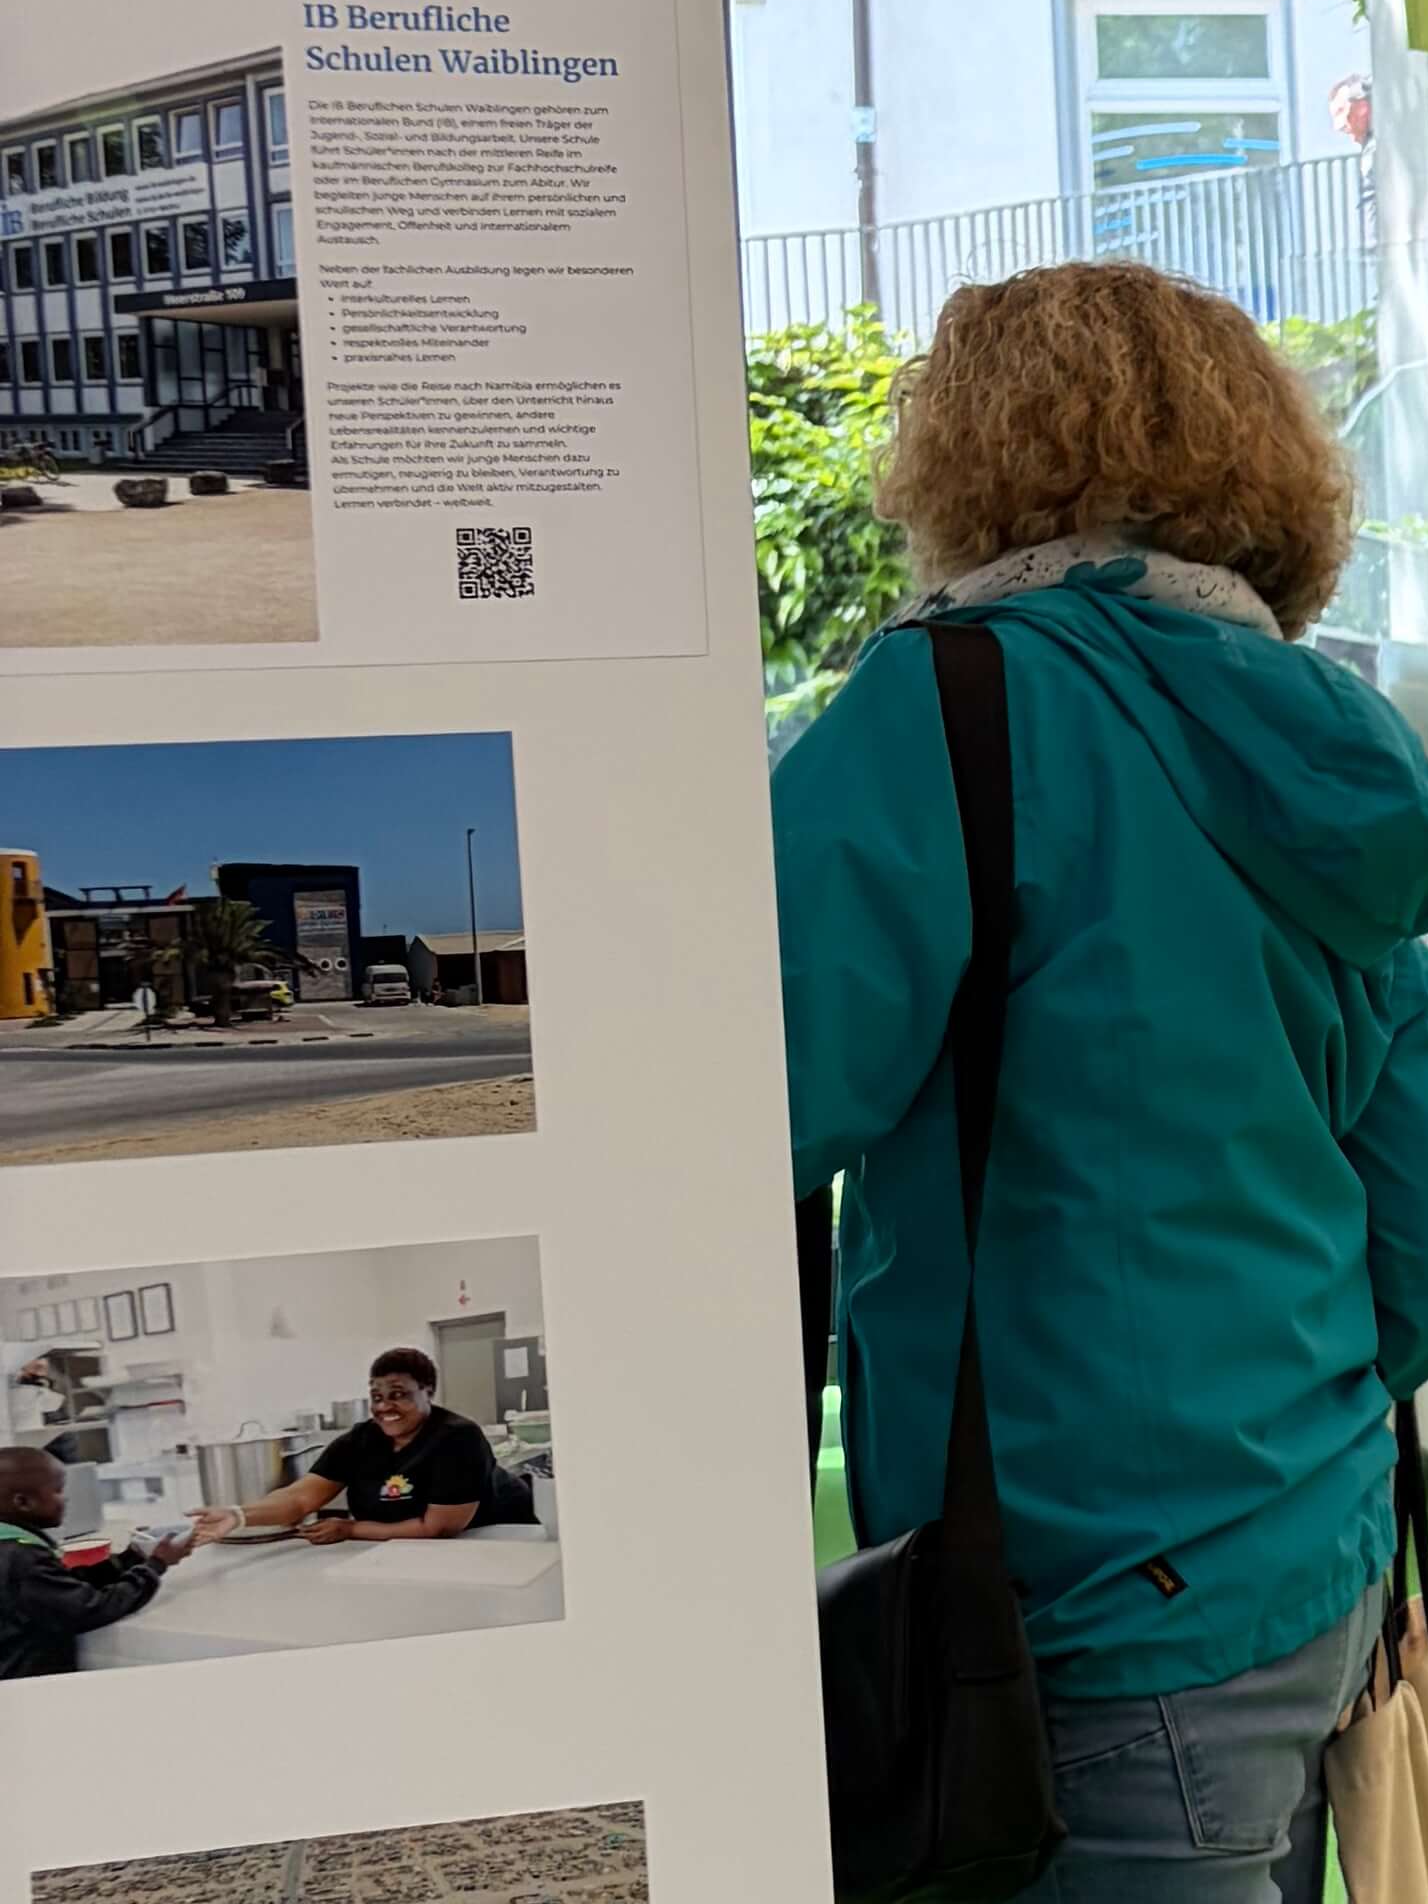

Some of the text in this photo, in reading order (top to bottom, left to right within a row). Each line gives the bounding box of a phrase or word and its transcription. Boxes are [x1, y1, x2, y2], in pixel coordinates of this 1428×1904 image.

[303, 2, 511, 35] IB Berufliche
[305, 45, 620, 81] Schulen Waiblingen
